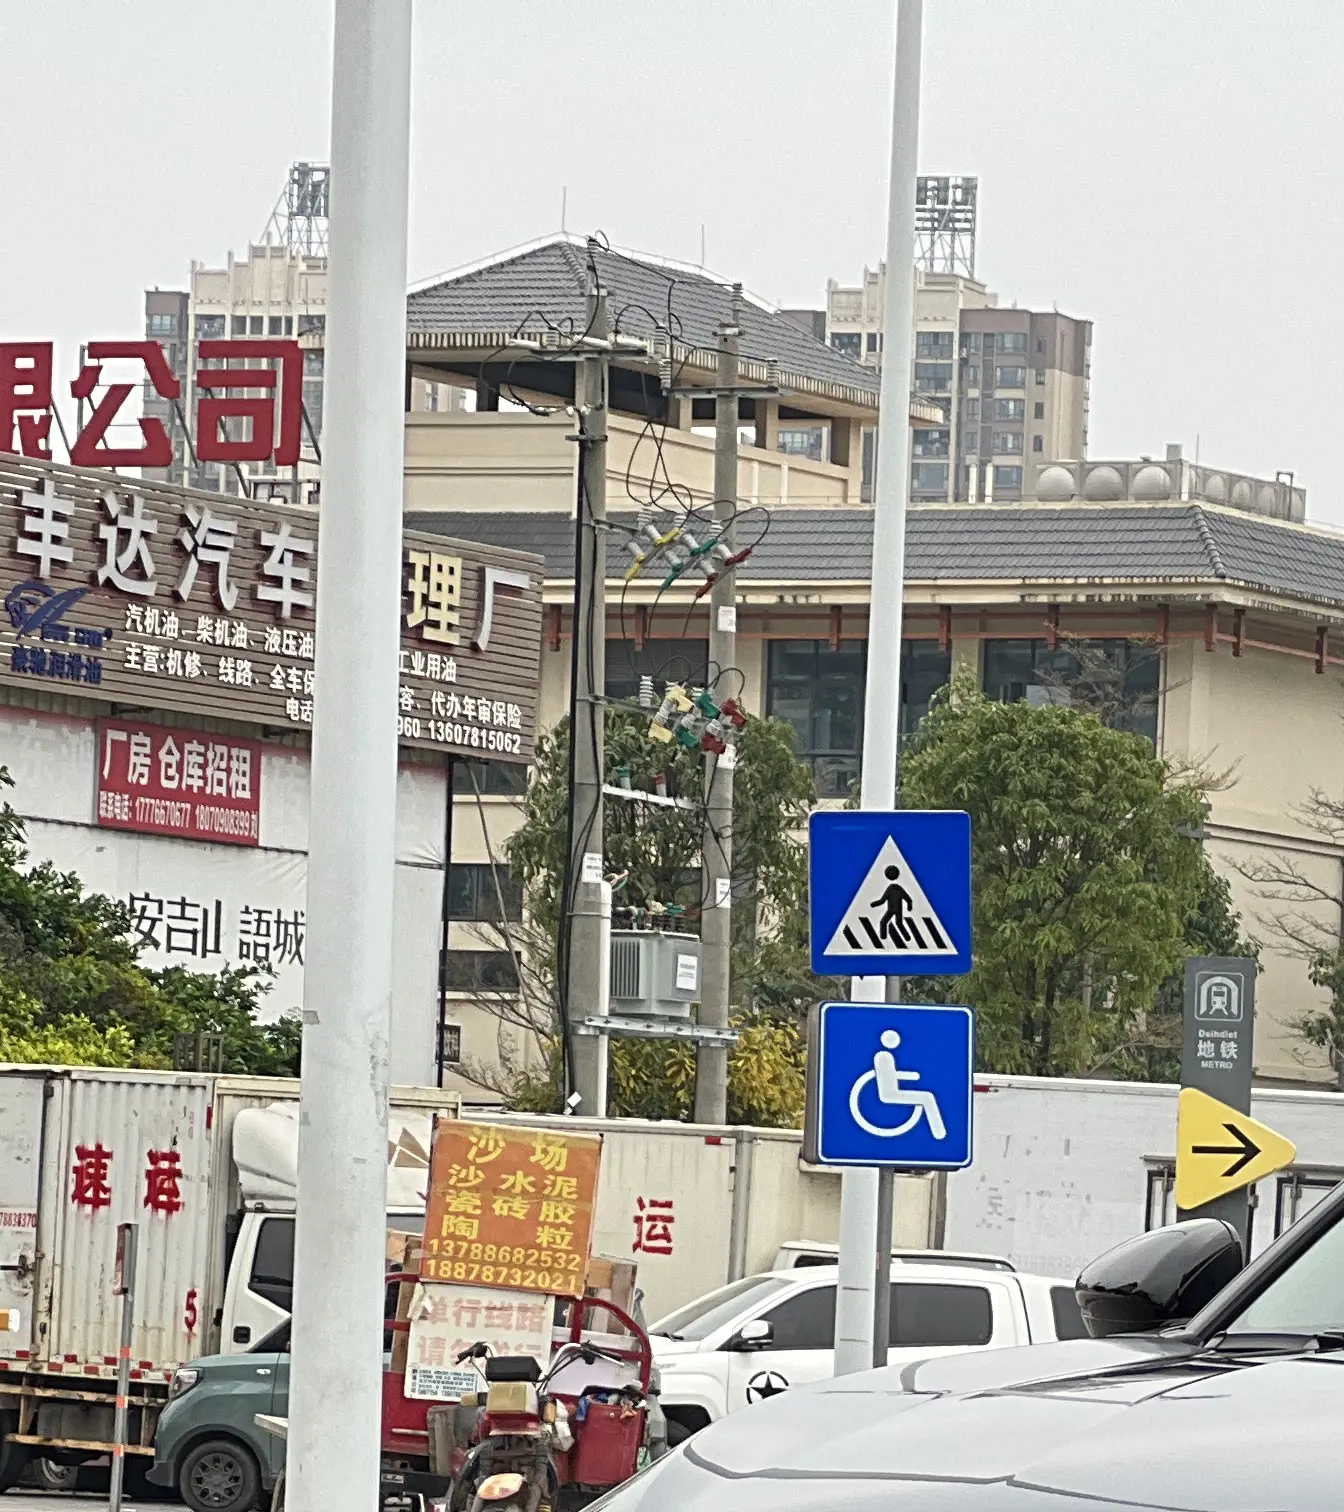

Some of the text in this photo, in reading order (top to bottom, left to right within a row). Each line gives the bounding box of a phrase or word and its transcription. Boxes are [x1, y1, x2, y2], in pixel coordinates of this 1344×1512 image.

[17, 478, 531, 652] 丰达汽车理厂
[428, 719, 521, 754] 13607815062
[1197, 1040, 1238, 1059] 地铁
[1200, 1060, 1234, 1069] METRO
[632, 1196, 676, 1255] 运
[429, 1238, 581, 1272] 13788682532
[426, 1259, 577, 1291] 18878732021
